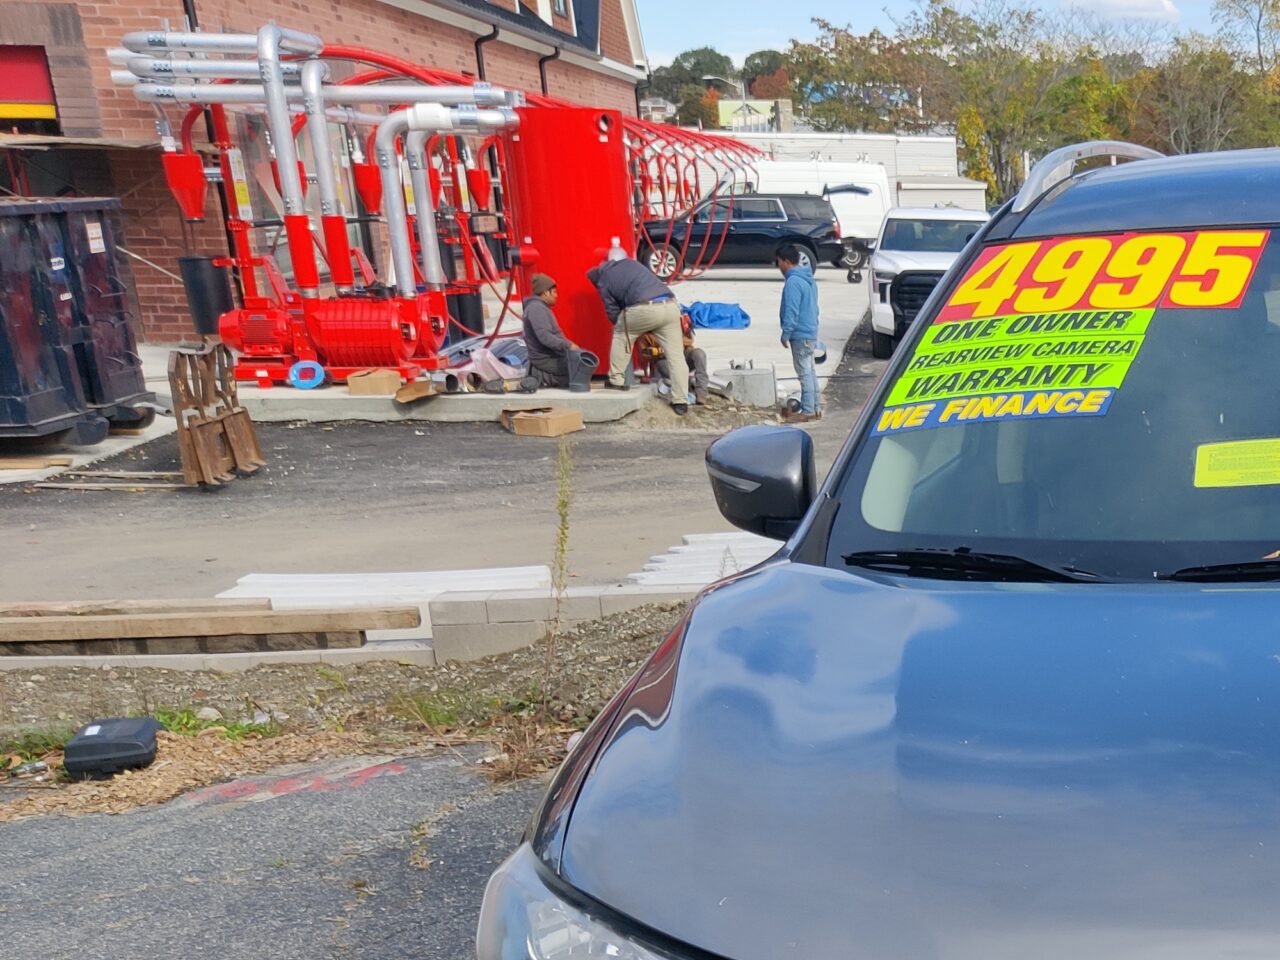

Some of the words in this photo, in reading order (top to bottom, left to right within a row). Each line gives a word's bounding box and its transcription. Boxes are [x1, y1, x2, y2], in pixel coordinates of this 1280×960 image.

[948, 233, 1262, 317] 4995
[931, 320, 1006, 346] ONE
[1006, 311, 1134, 336] OWNER
[909, 343, 1032, 371] REARVIEW
[1031, 340, 1137, 359] CAMERA
[905, 363, 1111, 400] WARRANTY
[877, 403, 936, 432] WE
[939, 390, 1111, 422] FINANCE
